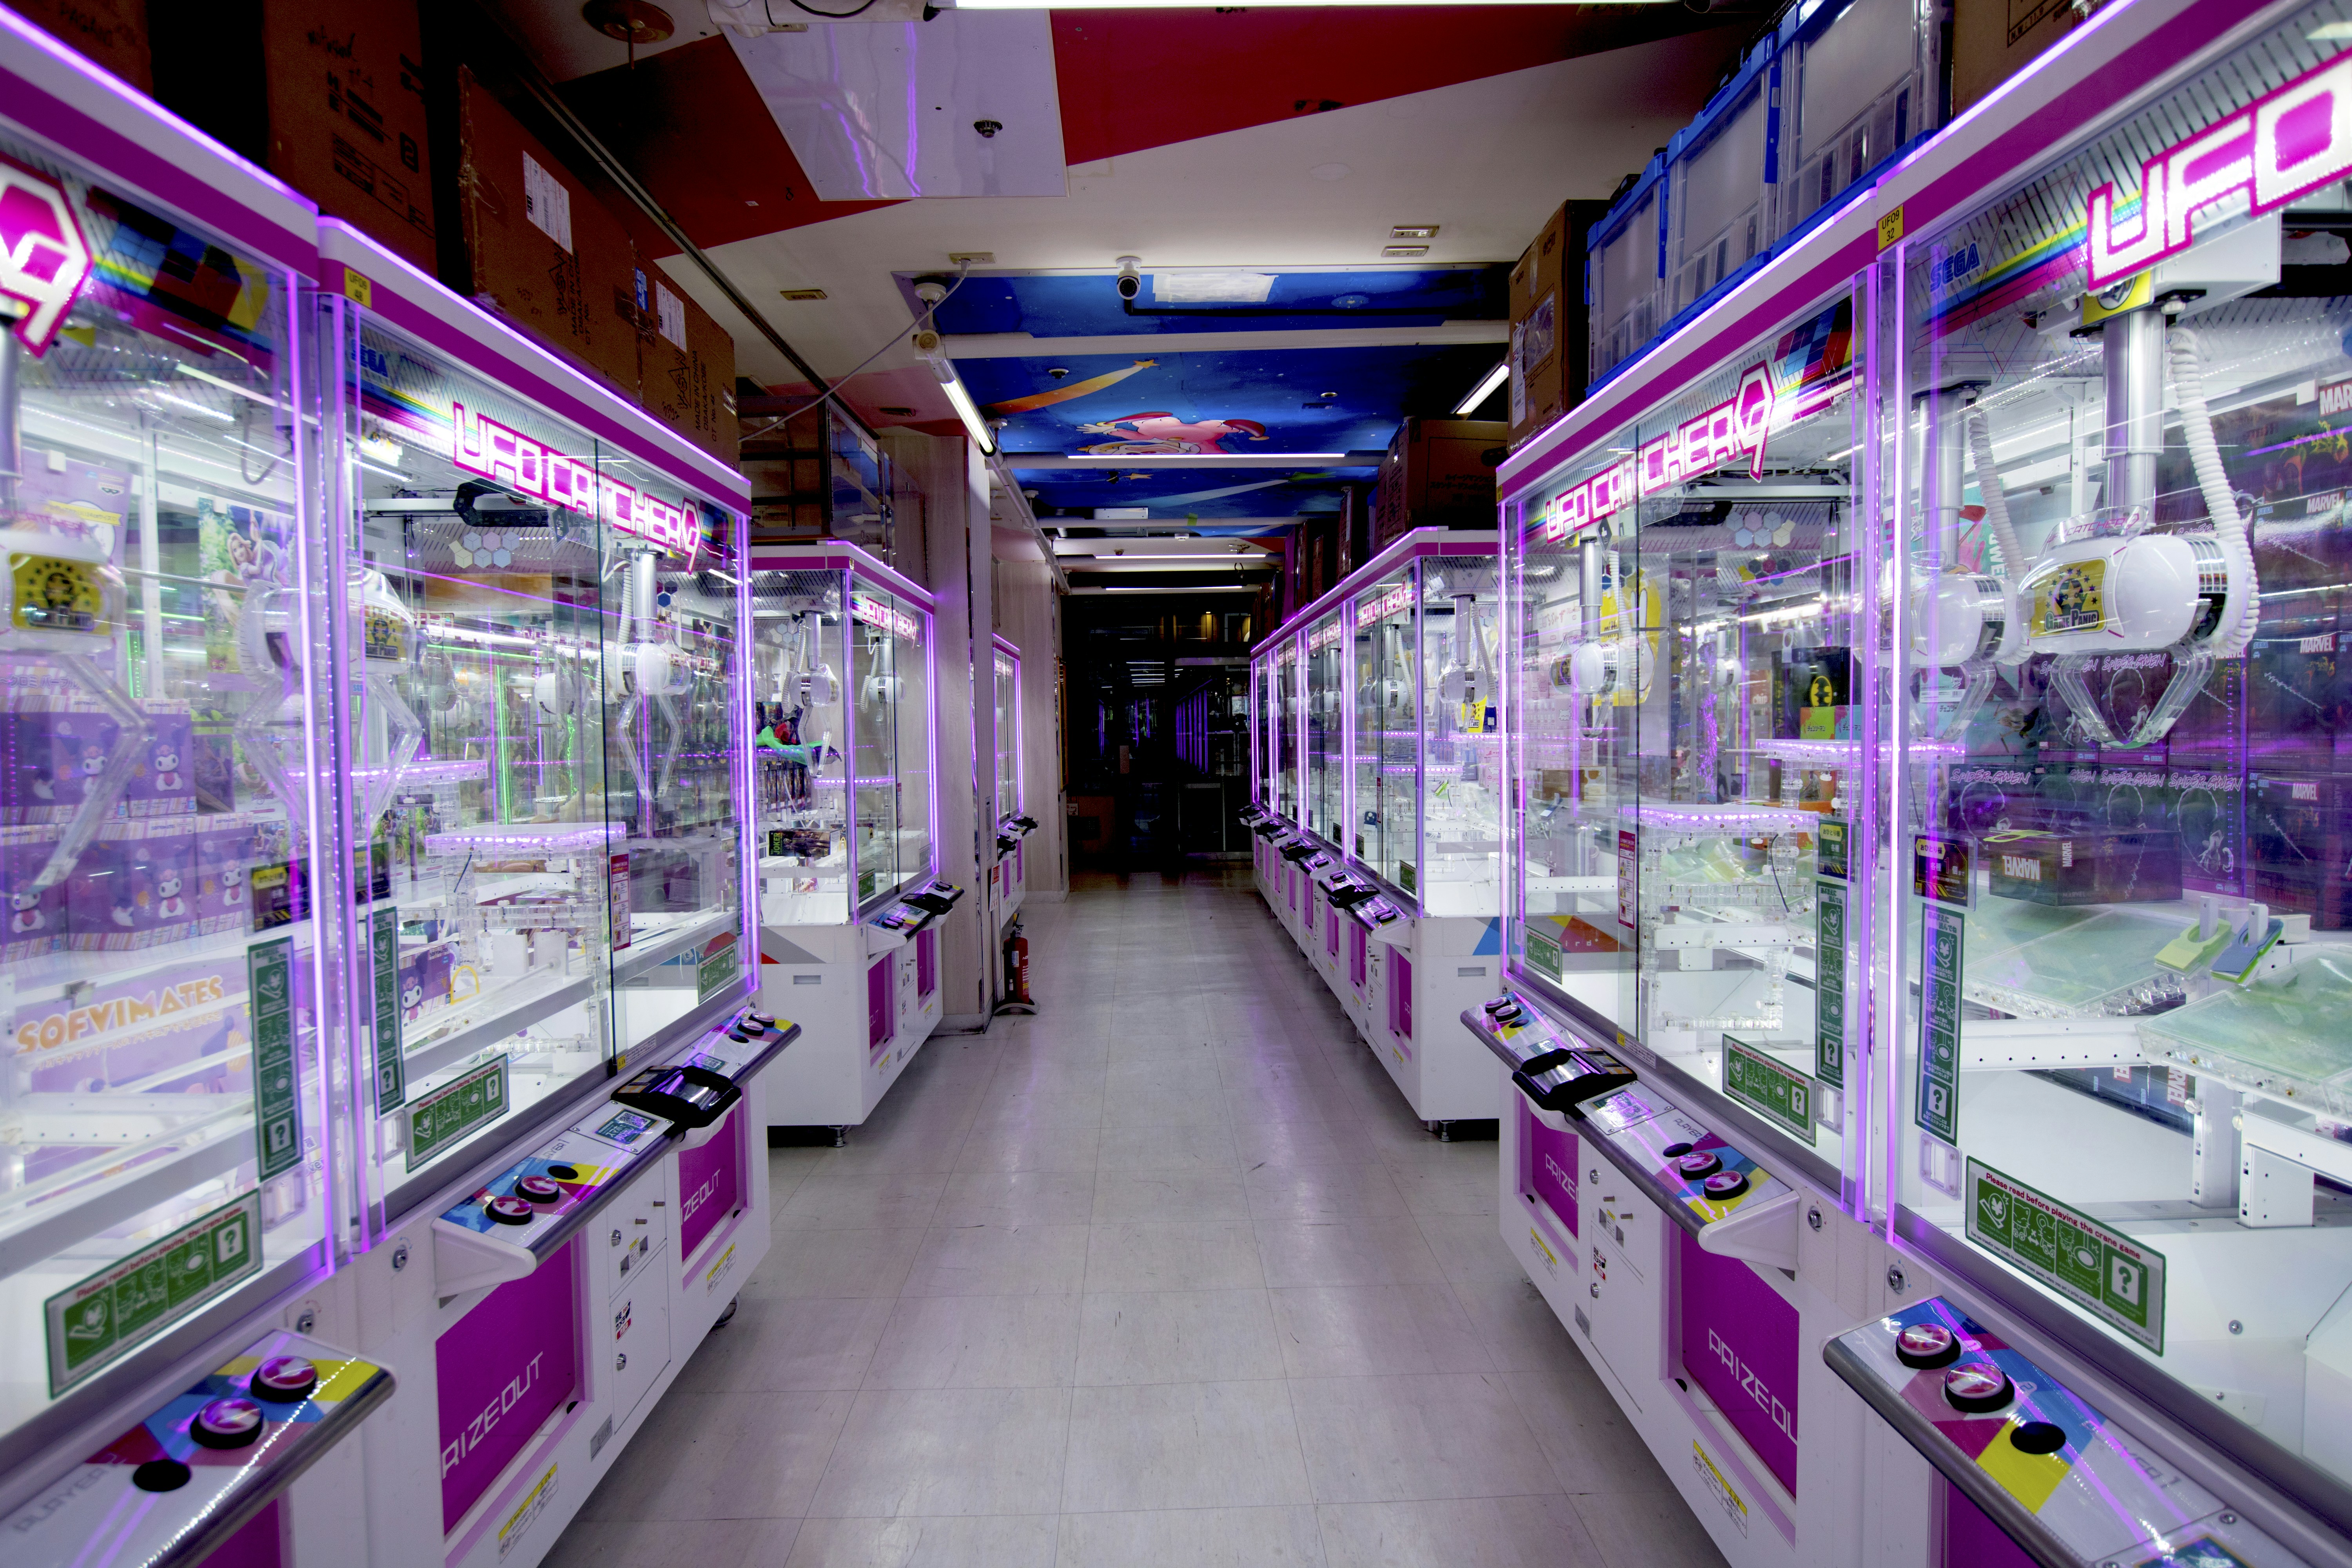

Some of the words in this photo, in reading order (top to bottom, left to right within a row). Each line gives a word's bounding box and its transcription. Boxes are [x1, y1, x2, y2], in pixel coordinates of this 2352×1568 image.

[1881, 212, 1900, 230] UFO9
[1886, 229, 1895, 242] 32
[1930, 242, 1981, 292] SEGA
[348, 272, 367, 290] UFO9
[354, 290, 363, 301] 48
[350, 338, 388, 378] SEGA
[693, 386, 700, 397] IN
[2320, 384, 2352, 415] MAR
[2257, 506, 2273, 516] SEGA
[2306, 492, 2342, 514] MARVEL
[2045, 612, 2069, 631] GAME
[2071, 609, 2098, 626] PANIC
[2300, 635, 2334, 653] MARVEL
[2102, 653, 2167, 672] SPIDER-GWEN
[2100, 769, 2166, 788] SPIDER-GWEN
[2169, 772, 2243, 792] SPIDER-GWEN
[2292, 783, 2318, 800] MARVEL
[1823, 829, 1840, 837] おひとり様
[1831, 844, 1840, 853] 各種
[1920, 844, 1943, 855] おひとり様
[2062, 841, 2072, 867] MARVEL
[1930, 862, 1942, 872] 各種
[2002, 855, 2040, 881] MARVEL
[16, 975, 224, 1055] SOFVIMATES
[1732, 1043, 1743, 1053] Please
[1753, 1054, 1764, 1064] before
[1764, 1060, 1777, 1071] playing
[1784, 1070, 1795, 1080] crane
[1795, 1076, 1805, 1085] game
[418, 1099, 432, 1109] Please
[443, 1086, 456, 1096] before
[456, 1079, 470, 1089] playing
[478, 1069, 489, 1077] crane
[489, 1064, 499, 1072] game
[2167, 1067, 2187, 1103] RVEL
[1544, 1152, 1579, 1203] PRIZE
[680, 1168, 721, 1225] IZEOUT
[1986, 1172, 2007, 1189] Please
[2009, 1185, 2024, 1199] read
[2027, 1193, 2049, 1211] before
[2052, 1208, 2078, 1226] playing
[2080, 1221, 2092, 1233] the
[2095, 1230, 2117, 1247] crane
[2120, 1241, 2141, 1259] game
[76, 1279, 106, 1299] Please
[109, 1268, 129, 1281] read
[130, 1252, 158, 1270] before
[159, 1238, 186, 1256] playing
[188, 1230, 201, 1240] the
[1593, 1256, 1602, 1269] カメラ
[615, 1315, 625, 1331] カメラ
[1708, 1327, 1798, 1446] PRIZEO
[441, 1351, 544, 1479] RIZEOUT
